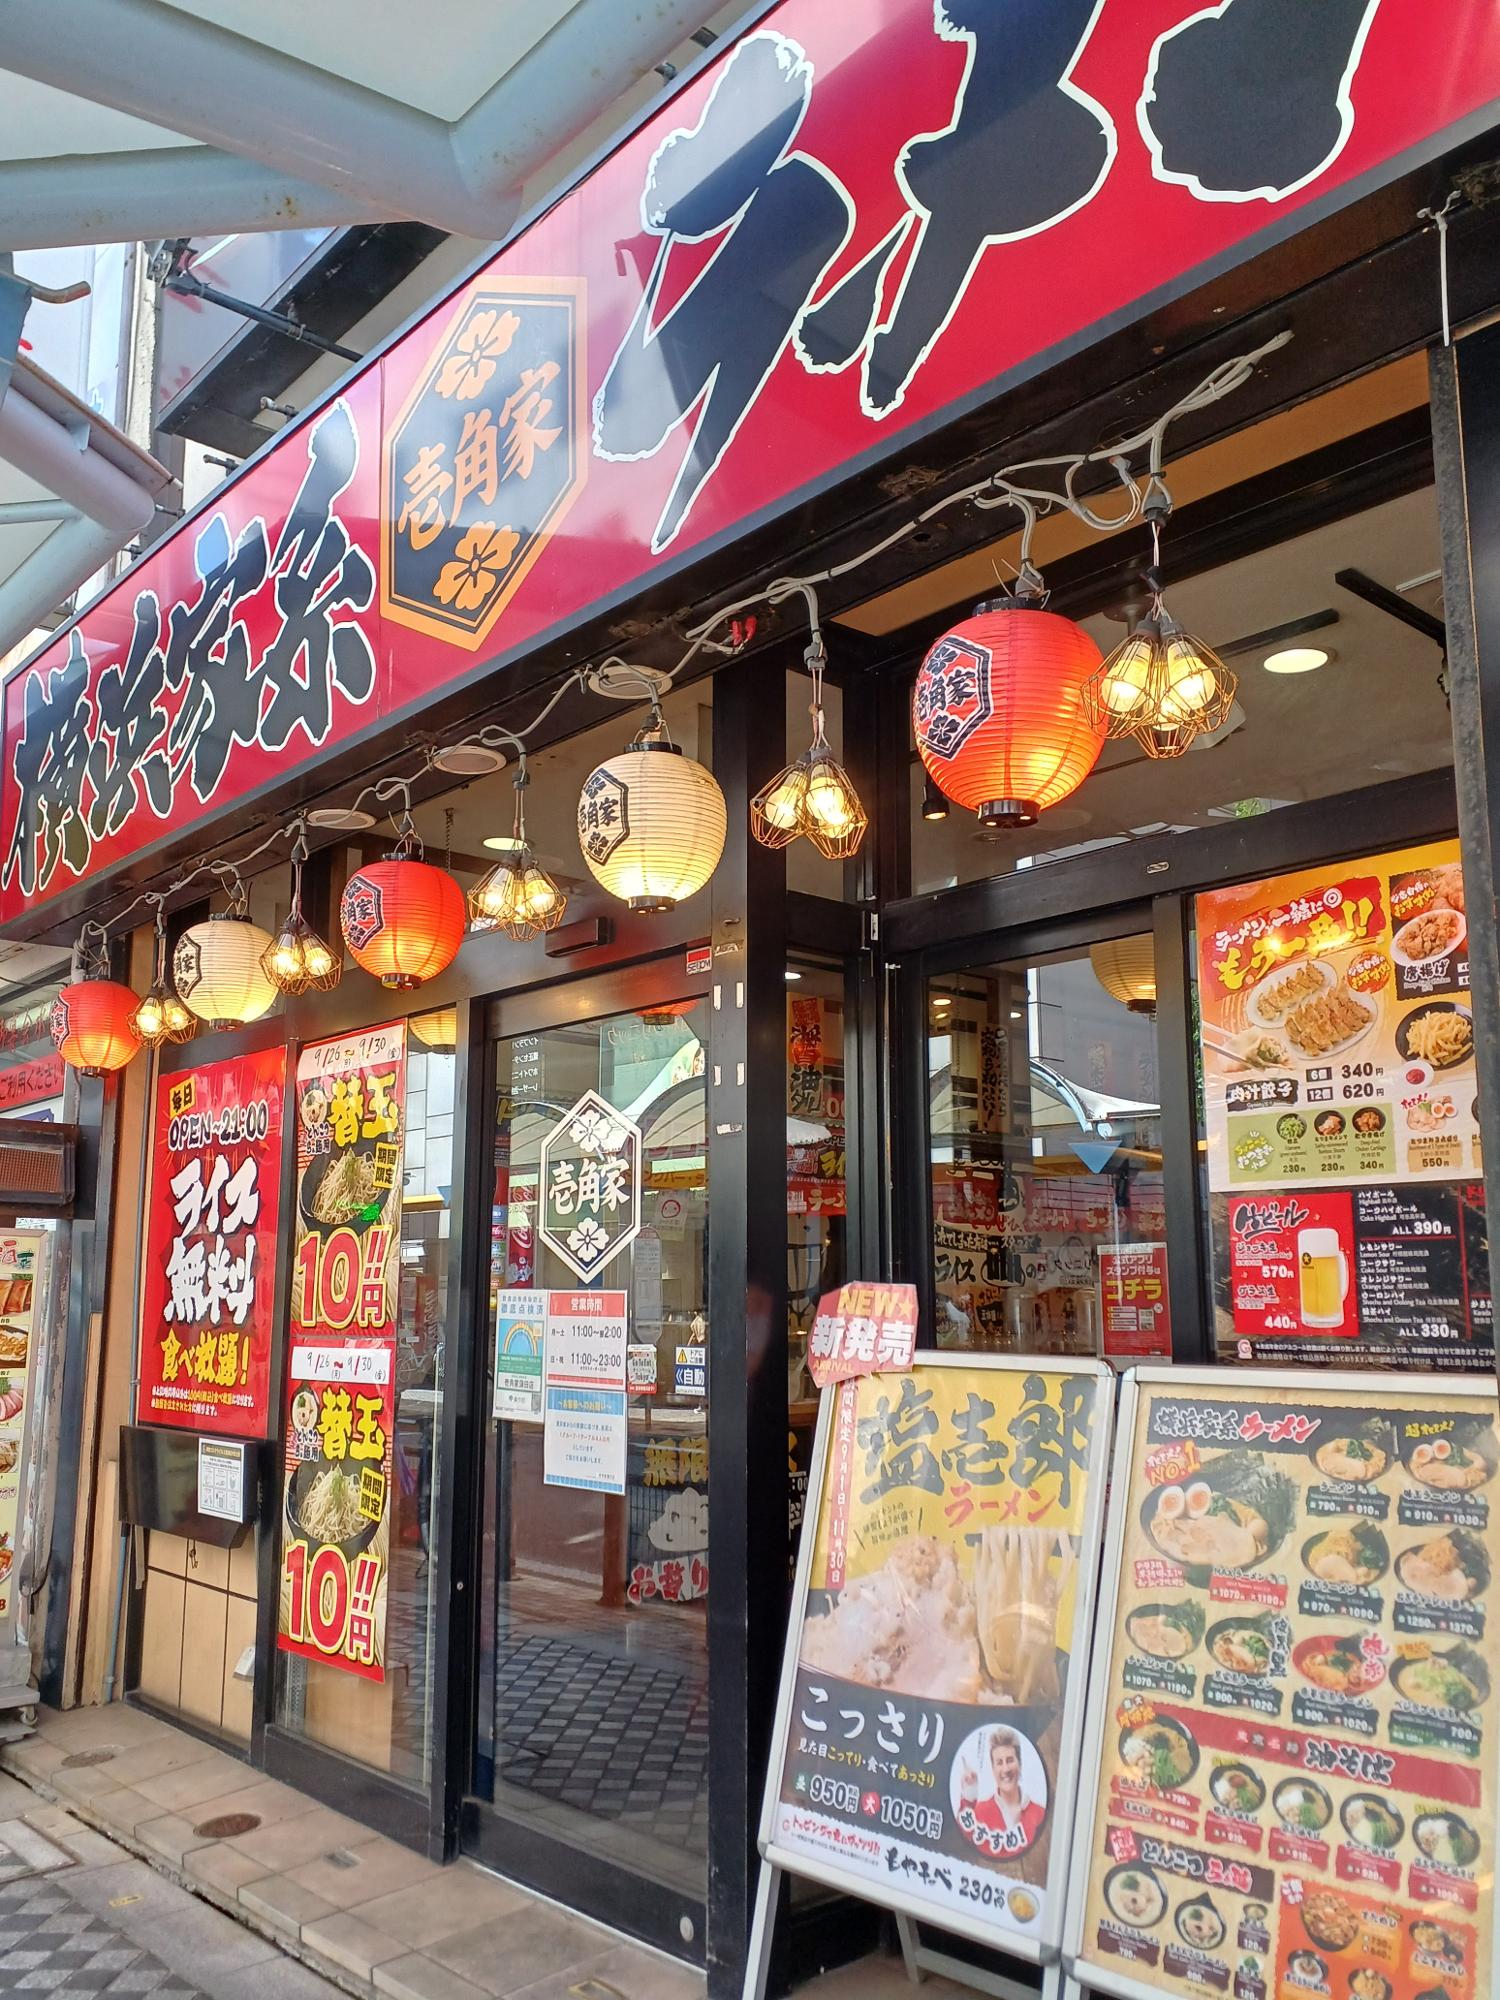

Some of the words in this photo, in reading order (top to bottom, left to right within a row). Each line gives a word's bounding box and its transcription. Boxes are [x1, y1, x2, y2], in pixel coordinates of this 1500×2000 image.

[397, 360, 562, 548] 壱角家
[1404, 958, 1450, 982] 唐揚げ
[1230, 1080, 1293, 1101] 肉汁餃子
[1341, 1062, 1384, 1079] 340円
[1342, 1082, 1385, 1099] 620円
[172, 1083, 193, 1113] 毎日
[326, 1073, 399, 1147] 替玉
[170, 1152, 259, 1244] ライス
[548, 1157, 631, 1217] 壱角家
[1391, 1225, 1412, 1235] ALL
[1413, 1220, 1452, 1235] 390円
[163, 1233, 255, 1325] 無料
[1106, 1278, 1163, 1301] コチラ
[1262, 1265, 1295, 1279] 570円
[837, 1289, 900, 1319] NEW
[1264, 1315, 1298, 1330] 440円
[810, 1314, 915, 1366] 新発売
[1398, 1328, 1420, 1337] ALL
[1421, 1324, 1459, 1339] 330円
[160, 1327, 251, 1386] 食べ放題!
[683, 1367, 705, 1386] 自動
[316, 1385, 386, 1461] 替玉
[1150, 1440, 1200, 1487] NO.1
[944, 1481, 1057, 1528] ラーメン
[801, 1686, 945, 1764] こっさり
[797, 1737, 936, 1789] 見た目こってり・食べてあっさり
[959, 1809, 1028, 1855] おすすめ!
